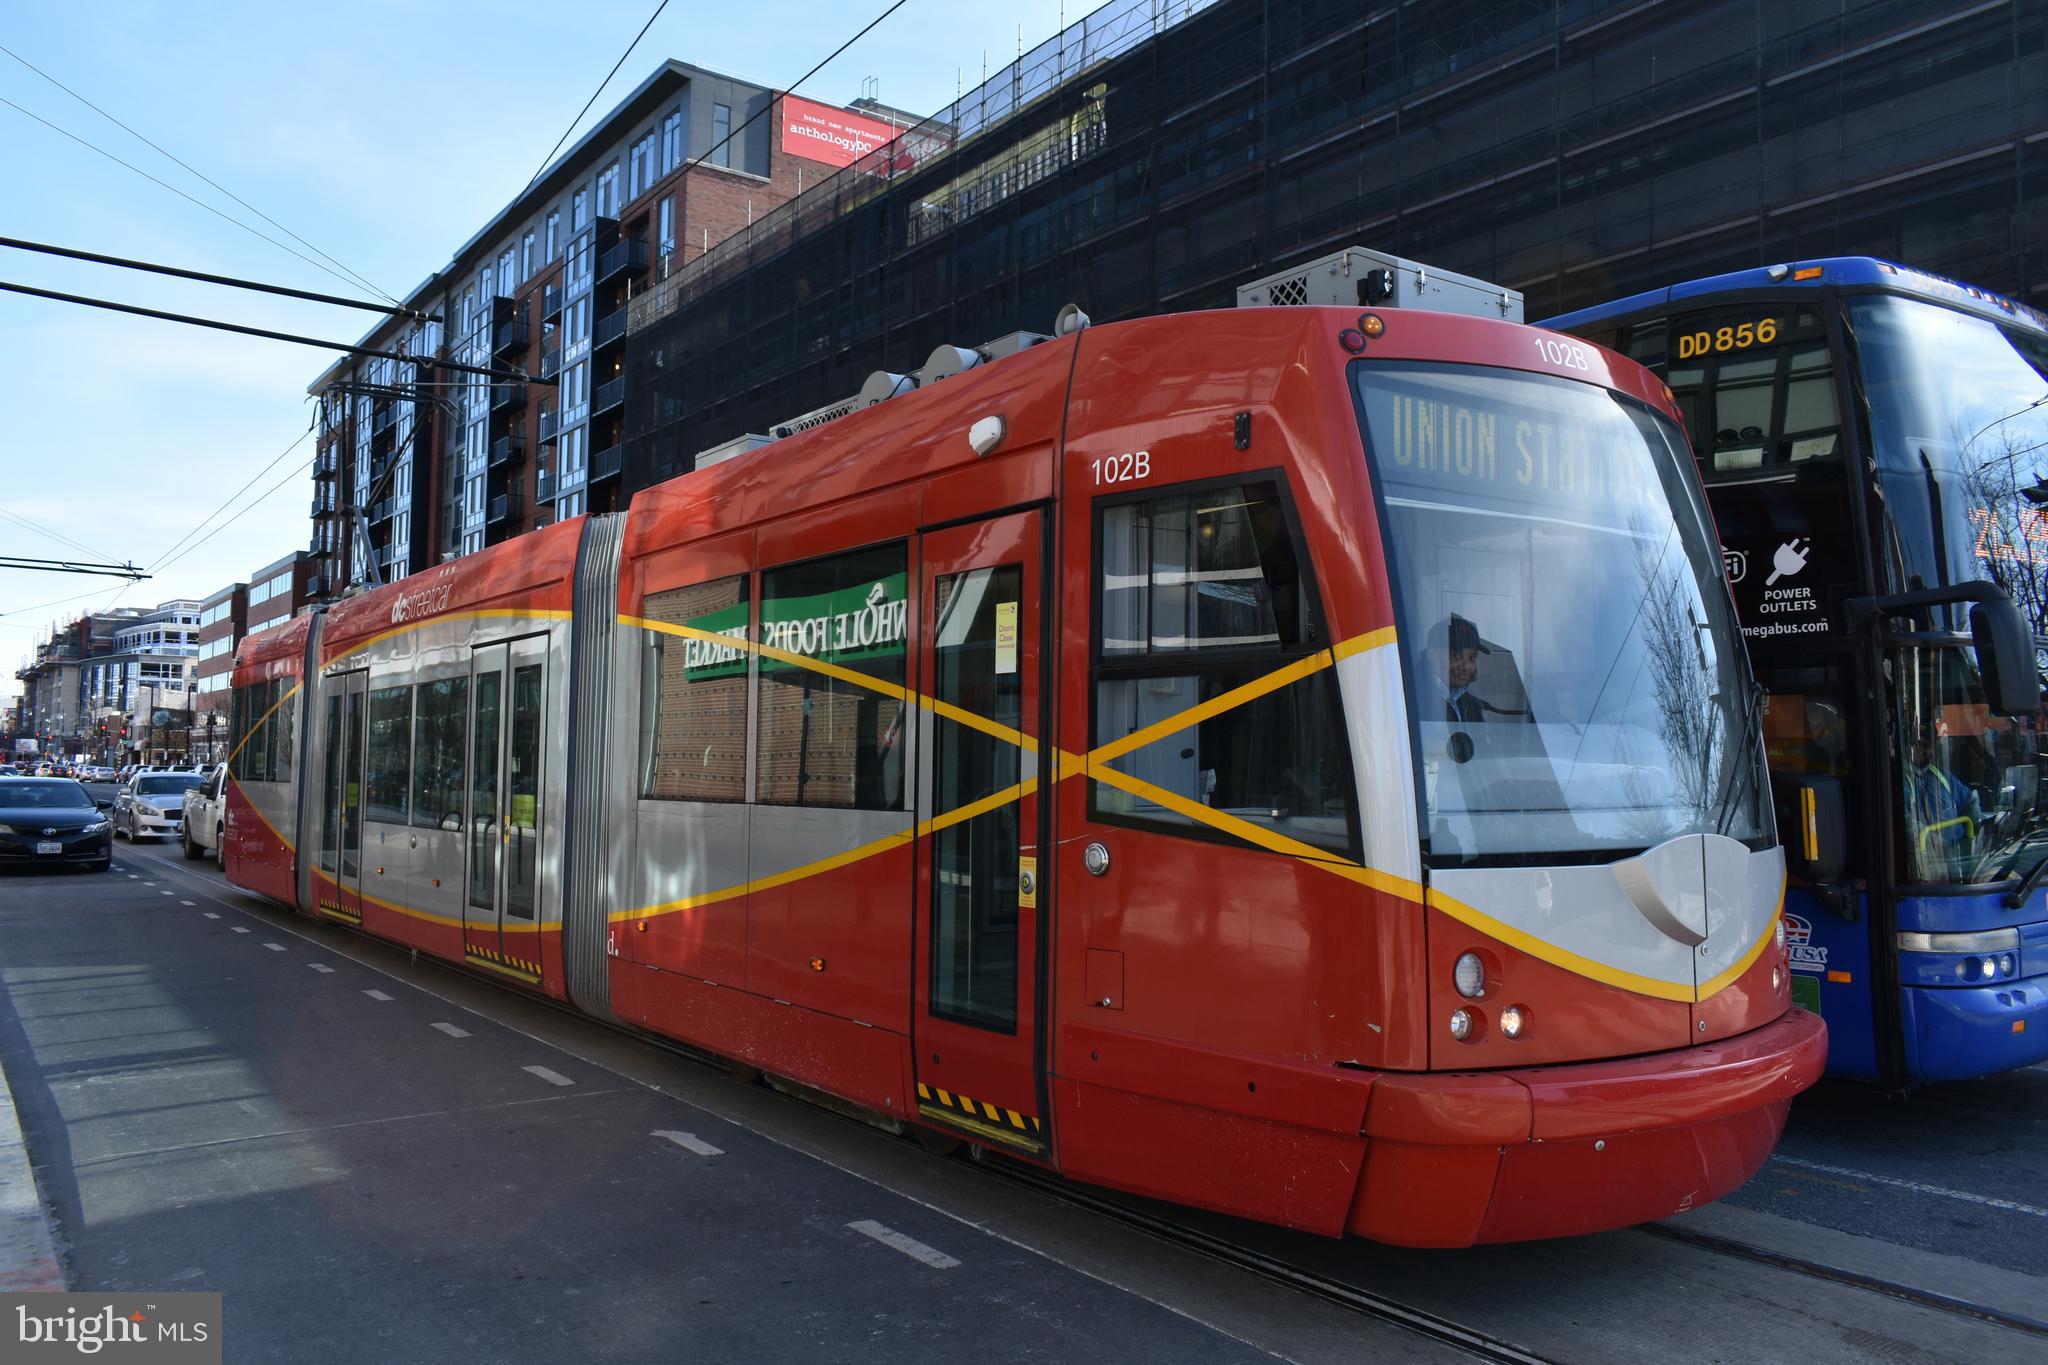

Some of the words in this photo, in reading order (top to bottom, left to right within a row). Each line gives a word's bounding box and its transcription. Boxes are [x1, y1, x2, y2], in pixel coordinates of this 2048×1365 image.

[803, 113, 825, 125] brand
[828, 121, 841, 129] new
[845, 126, 885, 142] apartments
[1534, 338, 1589, 371] 102B
[1393, 393, 1497, 480] UNION
[1091, 451, 1151, 486] 102B
[1759, 600, 1817, 613] OUTLETS
[1764, 587, 1811, 600] POWER
[1741, 622, 1829, 638] megabus.com
